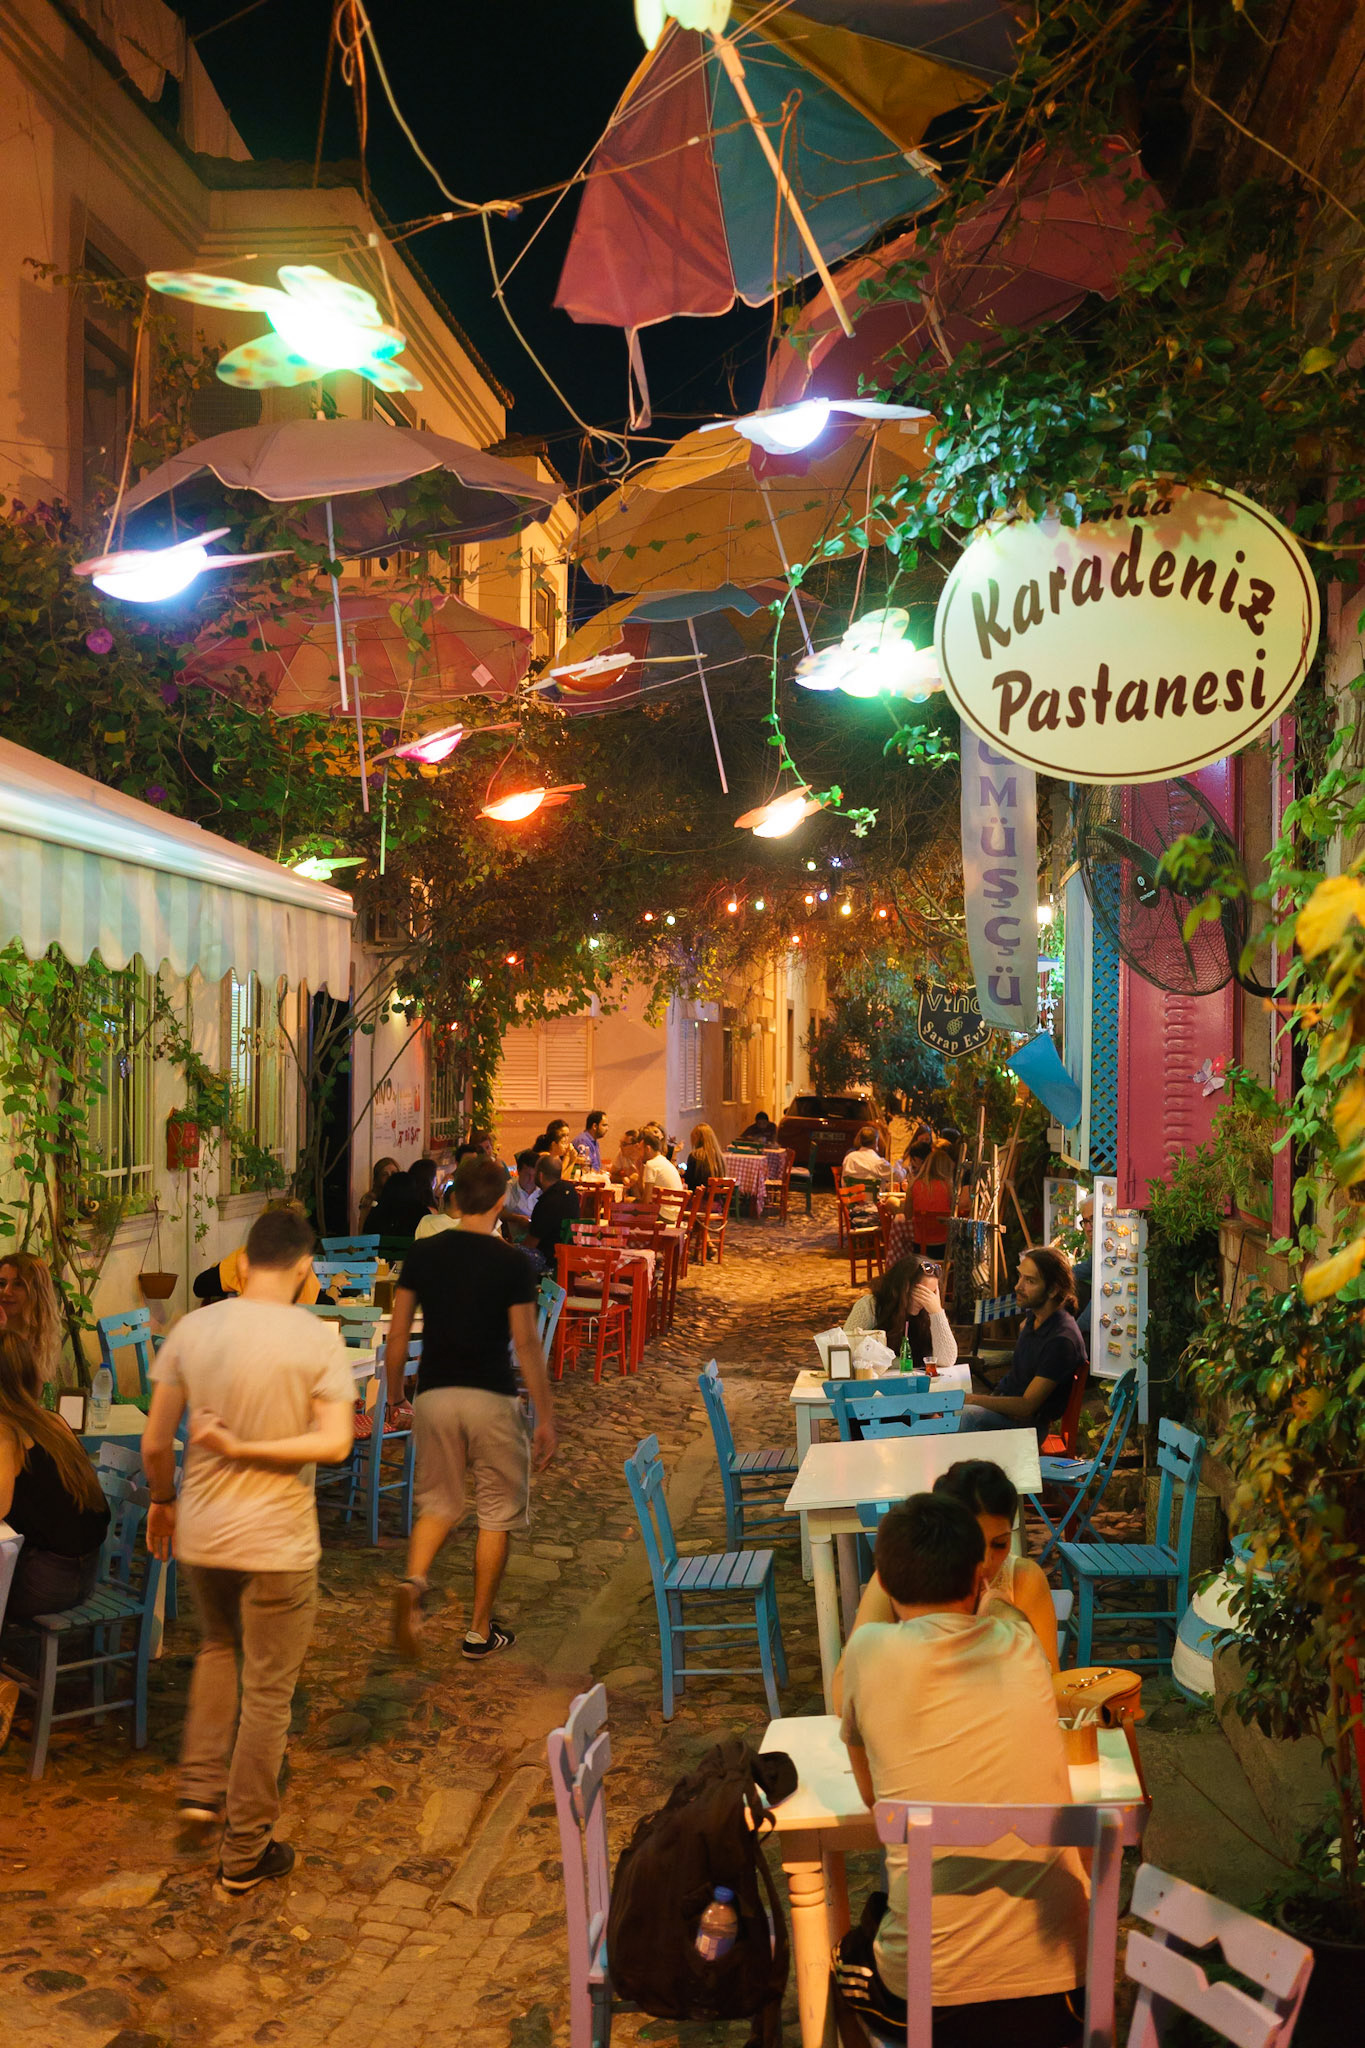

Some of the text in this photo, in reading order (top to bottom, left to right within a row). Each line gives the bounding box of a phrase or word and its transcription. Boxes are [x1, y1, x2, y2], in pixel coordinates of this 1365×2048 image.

[972, 524, 1275, 660] Karadeniz
[992, 648, 1266, 735] Pastanesi
[922, 1021, 986, 1053] Şarap Evi
